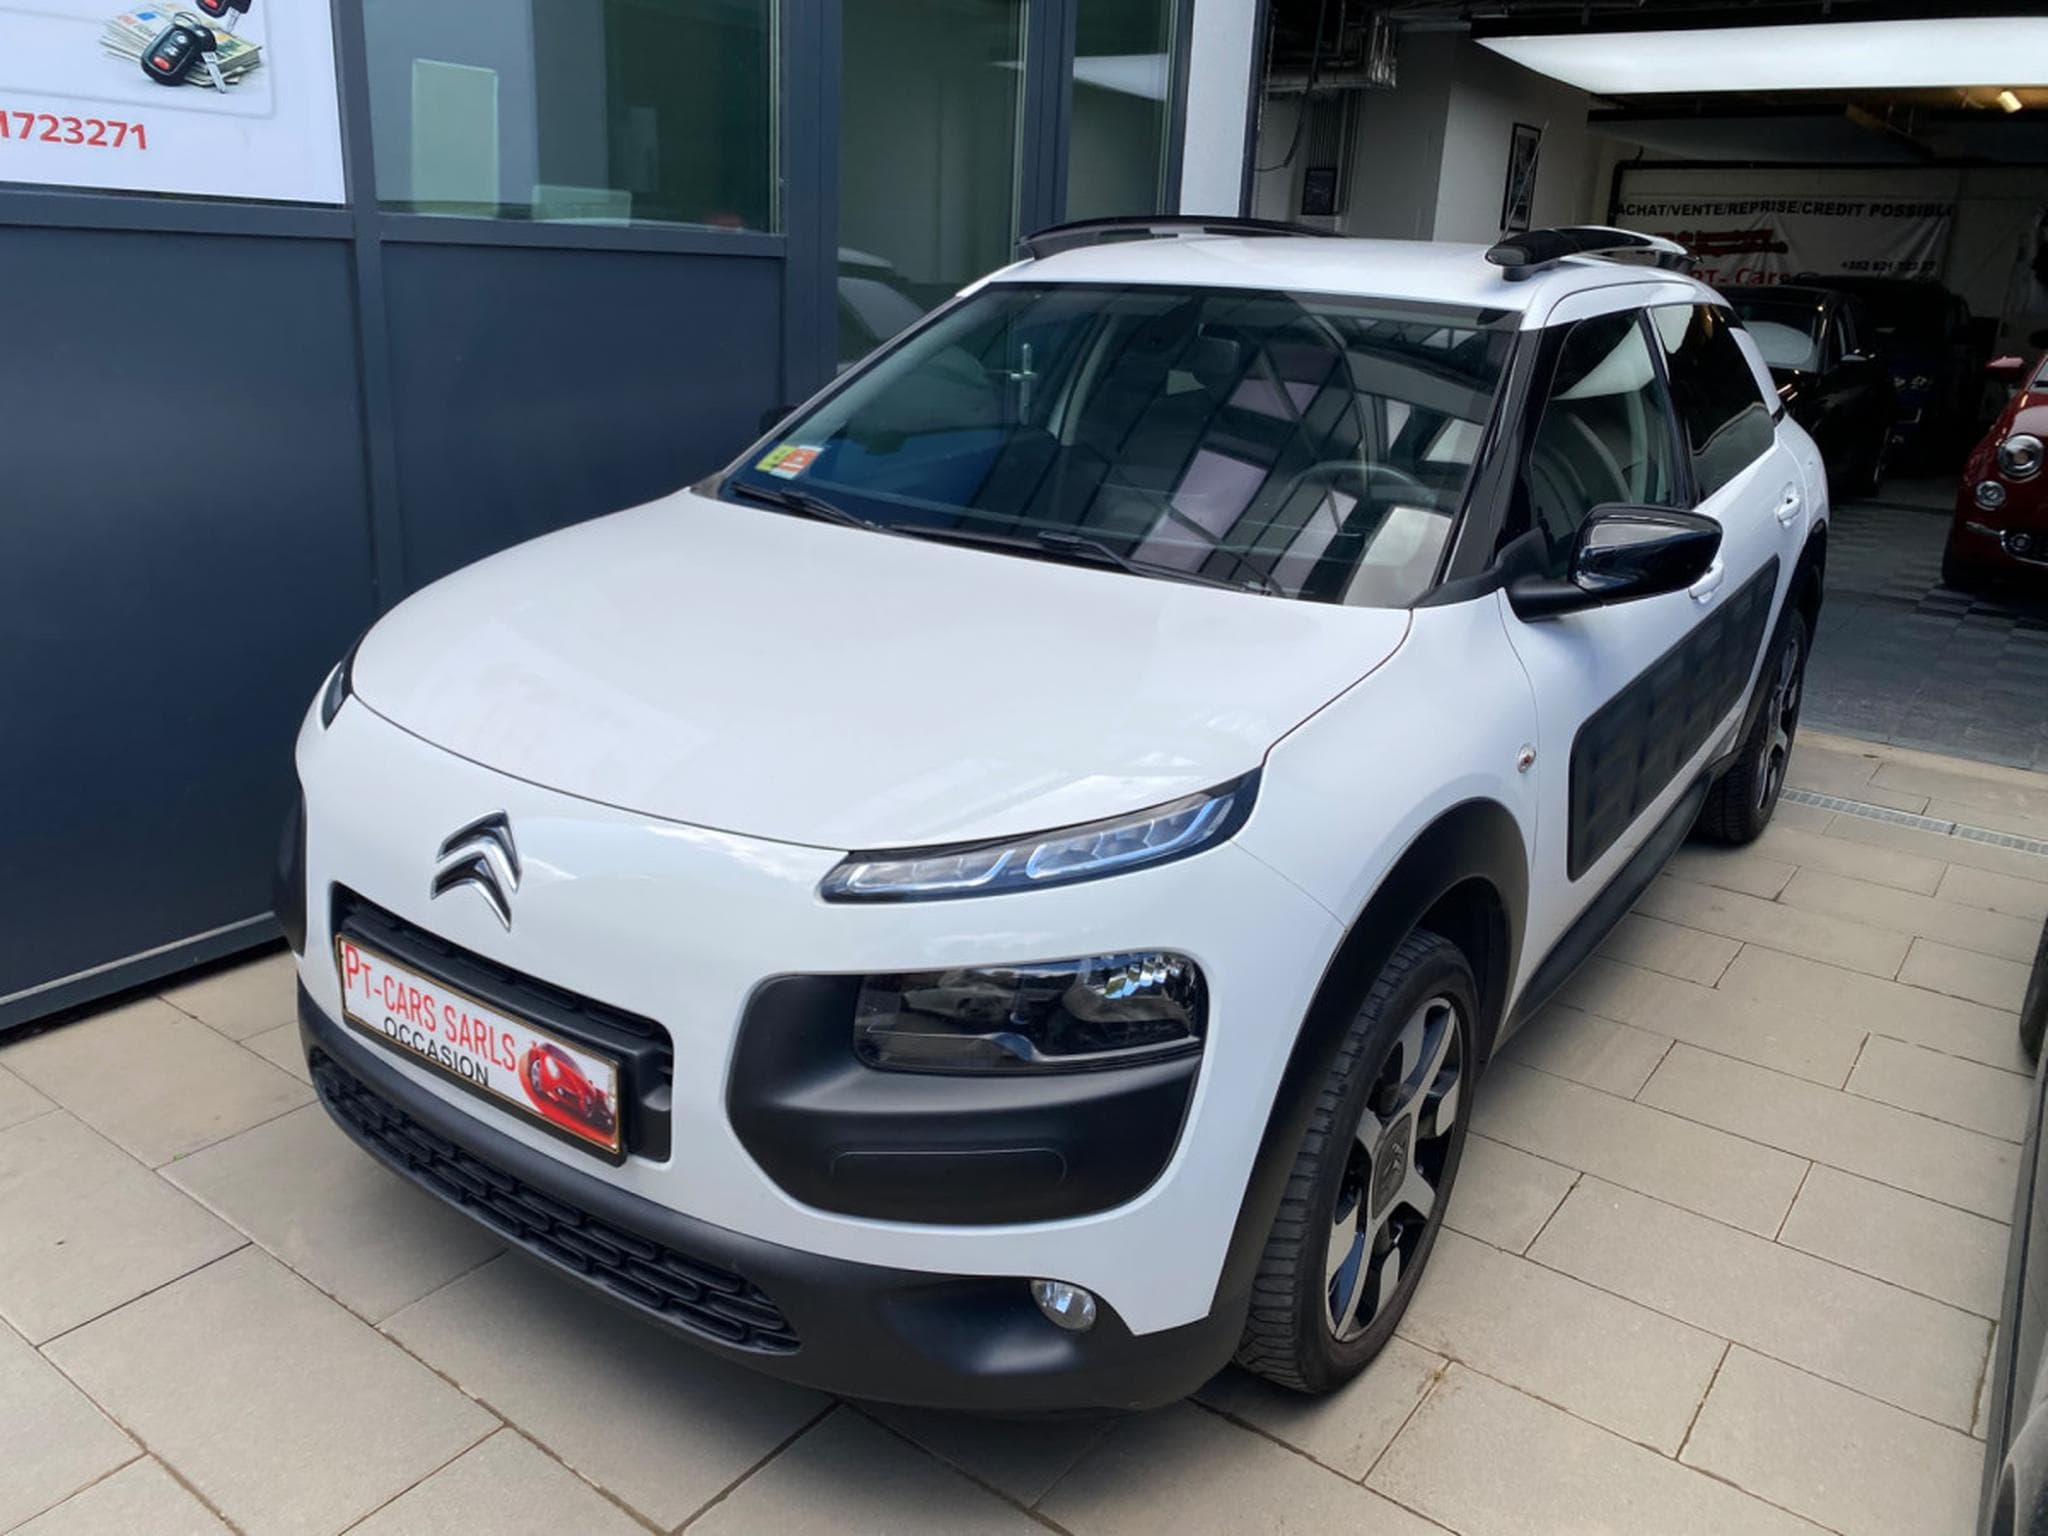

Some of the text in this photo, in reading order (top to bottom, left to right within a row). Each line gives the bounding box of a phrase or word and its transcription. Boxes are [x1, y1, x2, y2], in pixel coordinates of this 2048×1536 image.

[0, 110, 147, 150] 1723271
[345, 943, 517, 1073] PT-CARS SARLS
[383, 1016, 490, 1087] OCCASION
